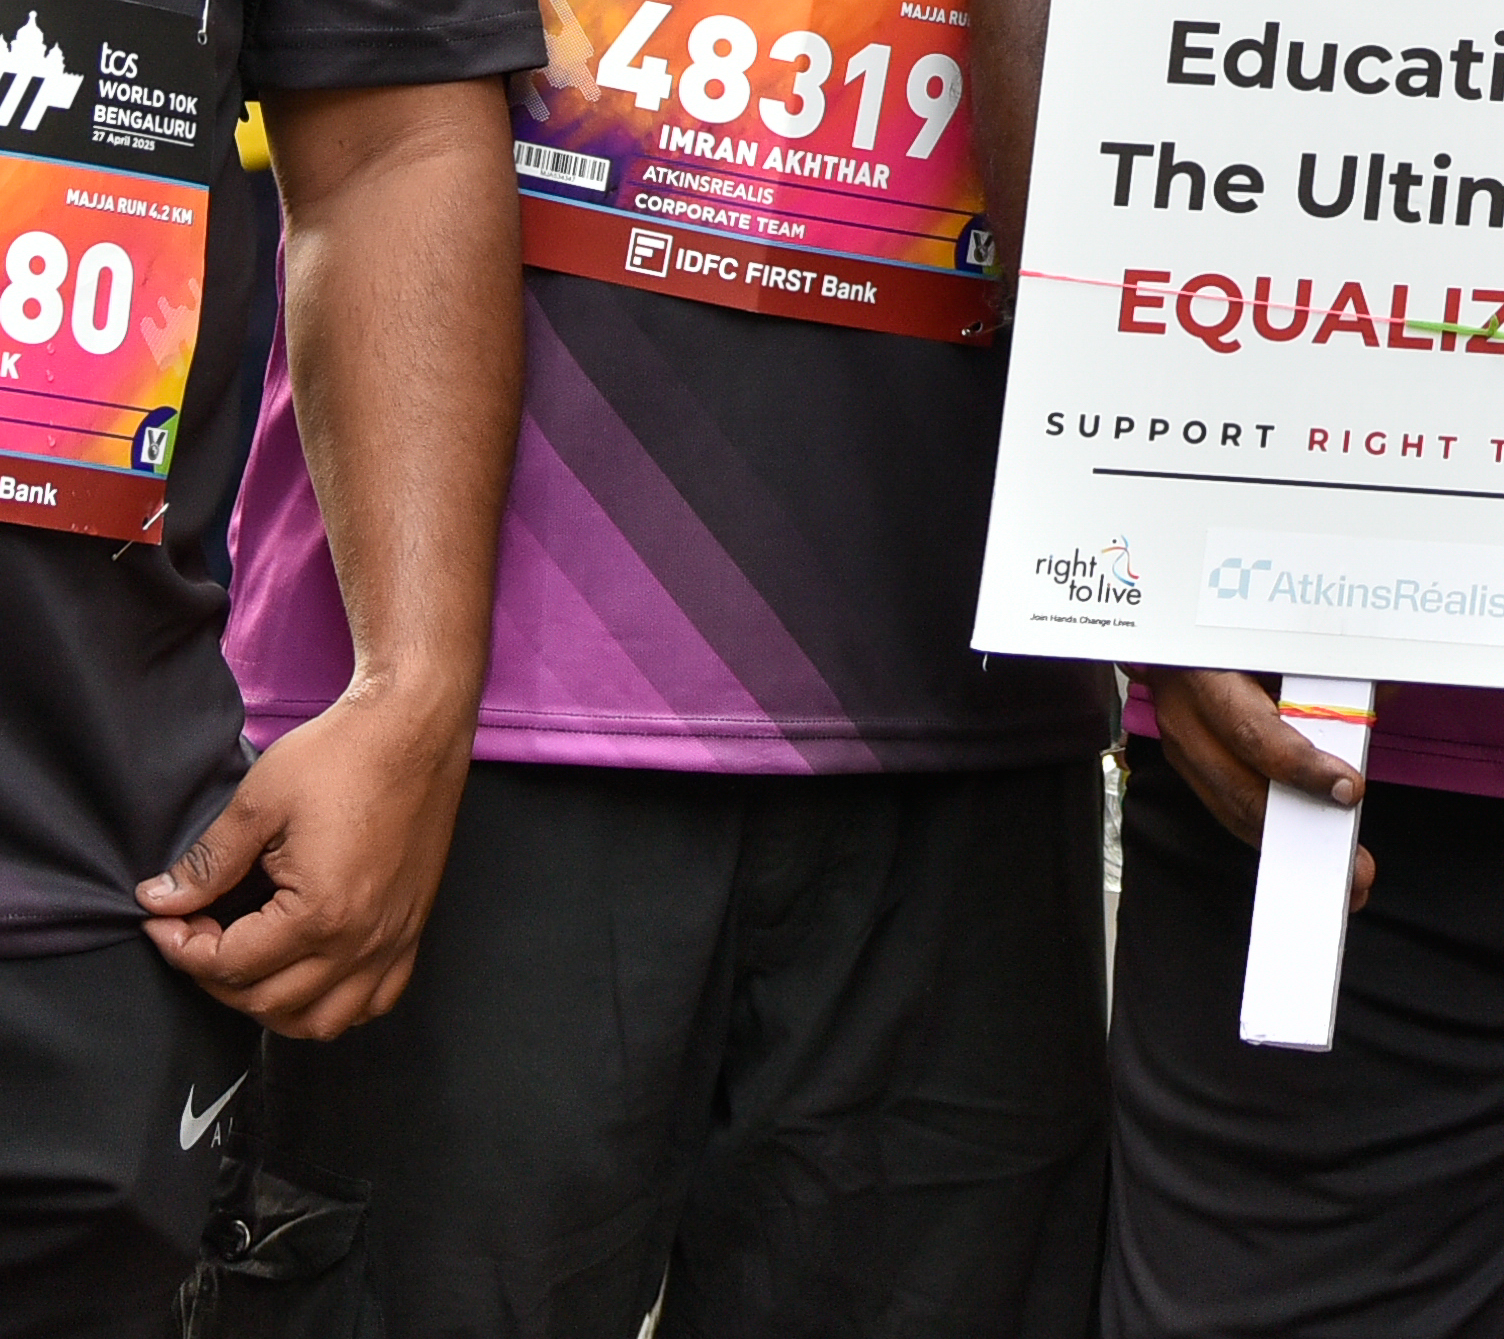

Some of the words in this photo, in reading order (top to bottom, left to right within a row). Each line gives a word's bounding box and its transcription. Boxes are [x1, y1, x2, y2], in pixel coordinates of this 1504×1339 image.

[900, 1, 945, 24] MAJJA
[99, 41, 139, 79] tcs
[97, 81, 164, 109] WORLD
[168, 92, 198, 116] 10K
[596, 0, 962, 161] 48319
[92, 105, 197, 140] BENGALURU
[92, 130, 104, 142] 27
[106, 133, 130, 151] April
[131, 137, 156, 151] 2025
[659, 124, 758, 168] IMRAN
[769, 148, 891, 190] AKHTHAR
[642, 164, 774, 205] ATKINSREALIS
[1100, 142, 1265, 215] The
[65, 187, 115, 213] MAJJA
[116, 194, 147, 217] RUN
[148, 198, 171, 220] 4.2
[171, 202, 193, 225] KM
[635, 193, 750, 231] CORPORATE
[757, 218, 805, 240] TEAM
[675, 248, 738, 281] IDFC
[744, 262, 817, 294] FIRST
[822, 275, 877, 304] Bank
[0, 353, 21, 380] K
[1045, 411, 1276, 450] SUPPORT
[1307, 427, 1461, 462] RIGHT
[1036, 548, 1097, 584] right
[1069, 580, 1093, 602] to
[1097, 574, 1142, 606] live
[1030, 612, 1048, 622] Join
